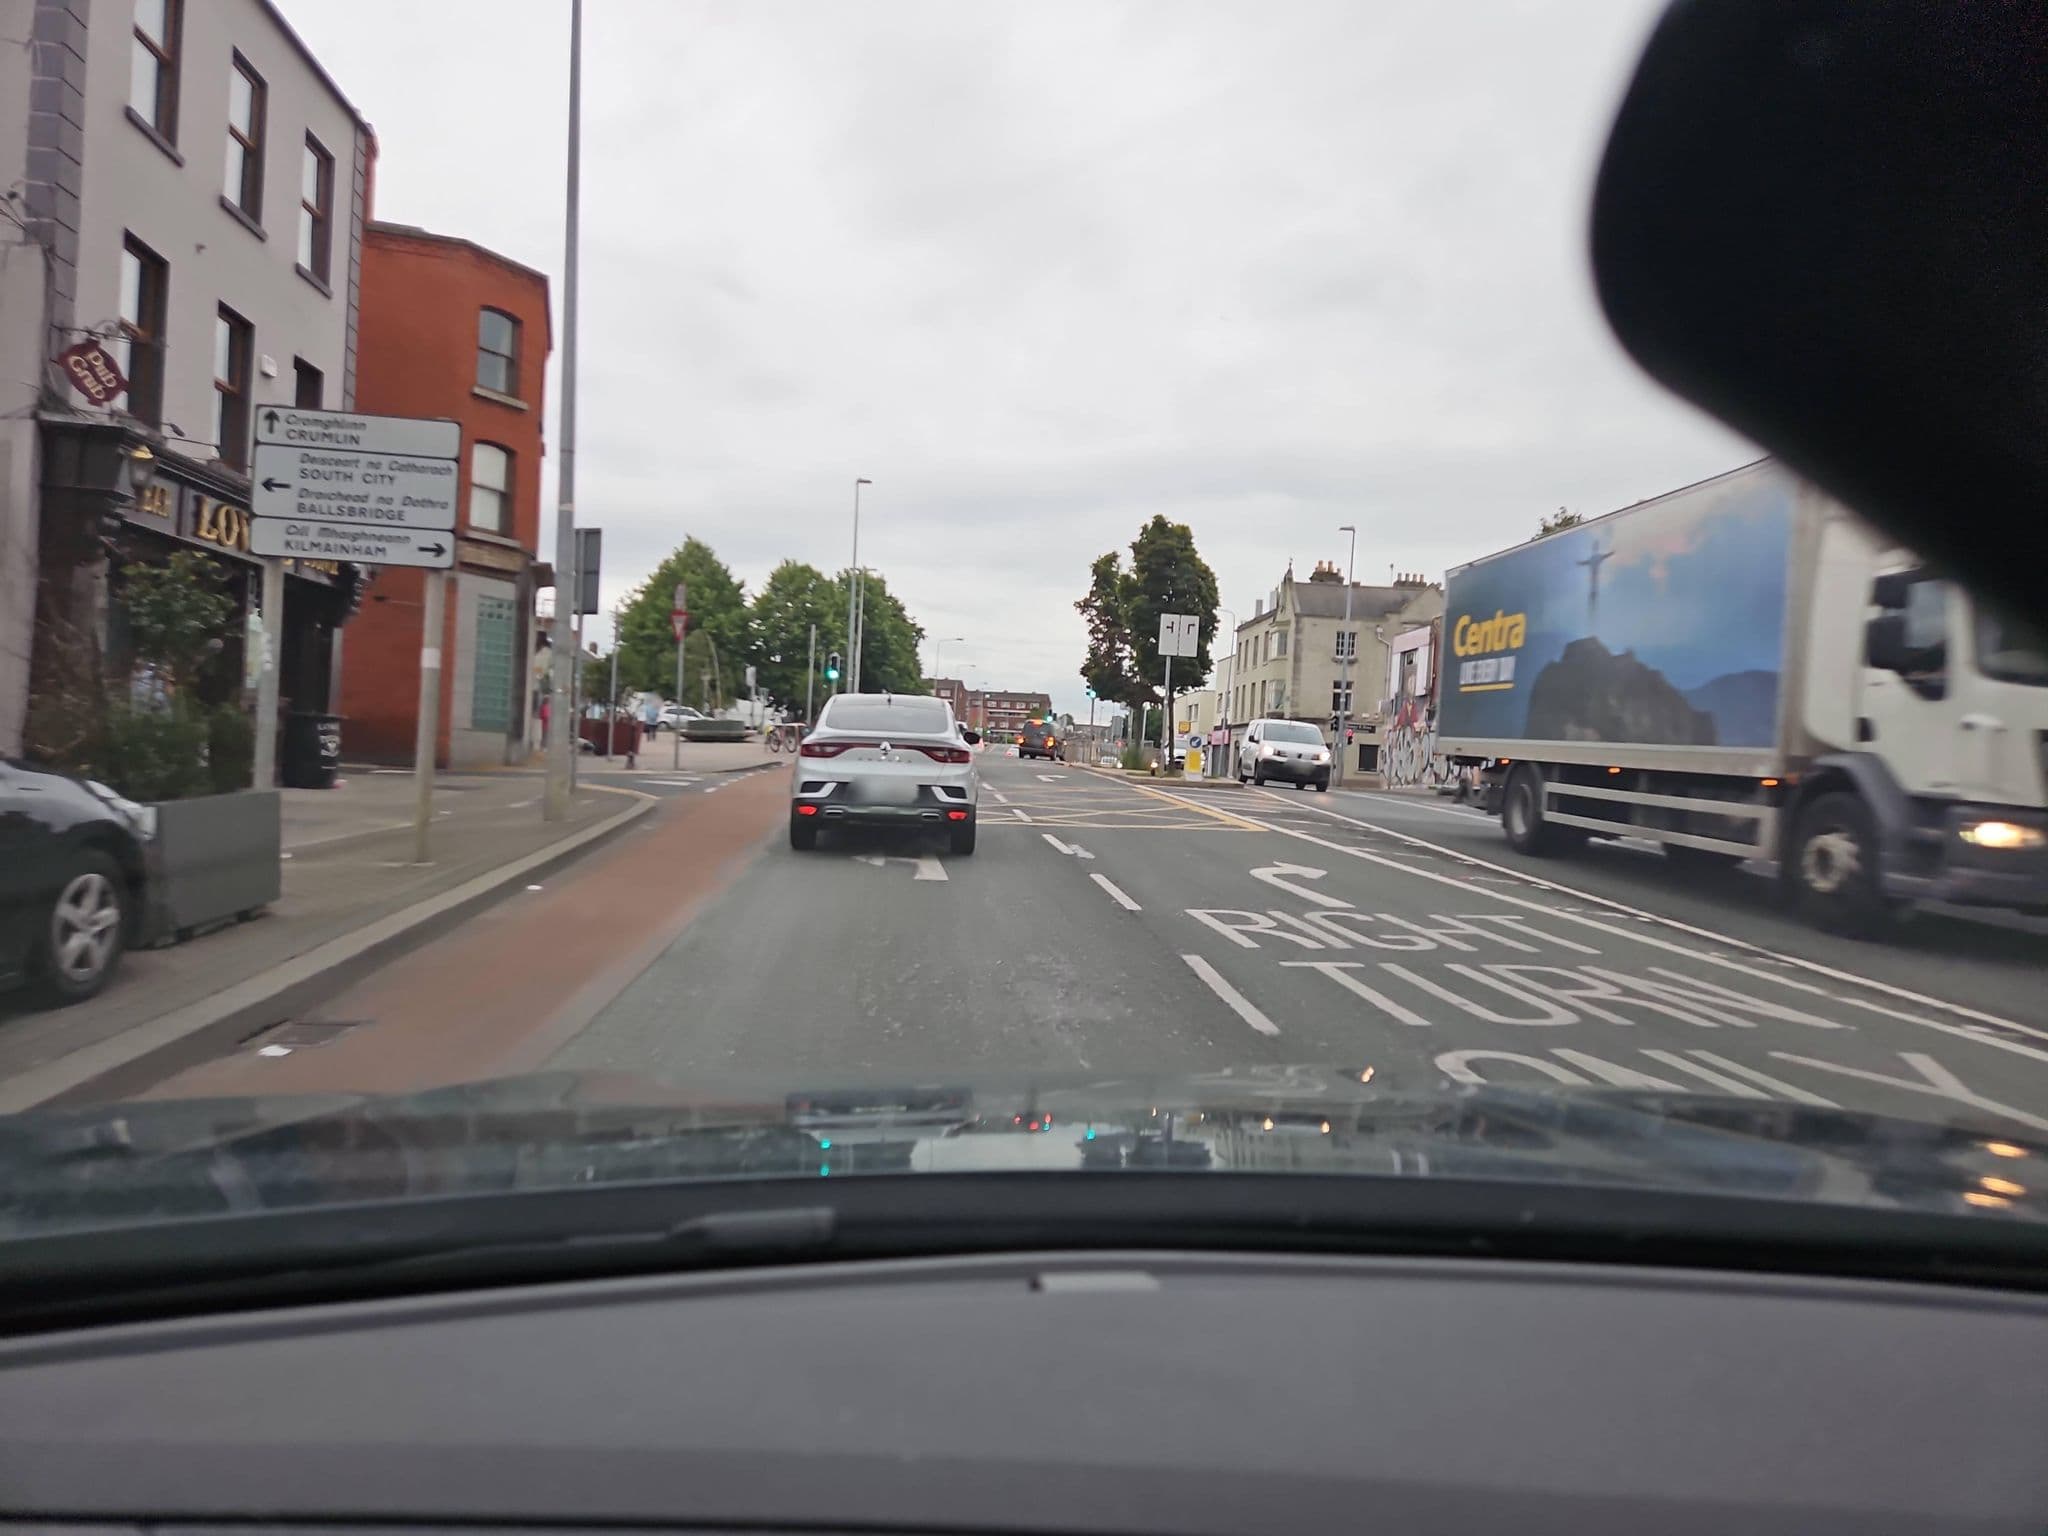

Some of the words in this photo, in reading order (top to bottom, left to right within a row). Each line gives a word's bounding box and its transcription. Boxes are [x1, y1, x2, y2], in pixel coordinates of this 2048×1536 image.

[68, 356, 105, 400] Grub
[85, 351, 117, 388] Pub
[286, 429, 360, 445] CRUMLIN
[366, 460, 382, 470] na
[299, 468, 353, 482] SOUTH
[362, 472, 396, 485] CITY
[377, 496, 394, 506] na
[297, 502, 405, 521] BALLSBRIDGE
[285, 525, 310, 537] Cill
[284, 540, 387, 557] KILMAINHAM
[1454, 609, 1527, 657] Centra
[1185, 907, 1602, 954] RIGHT
[1280, 961, 1857, 1030] TURN
